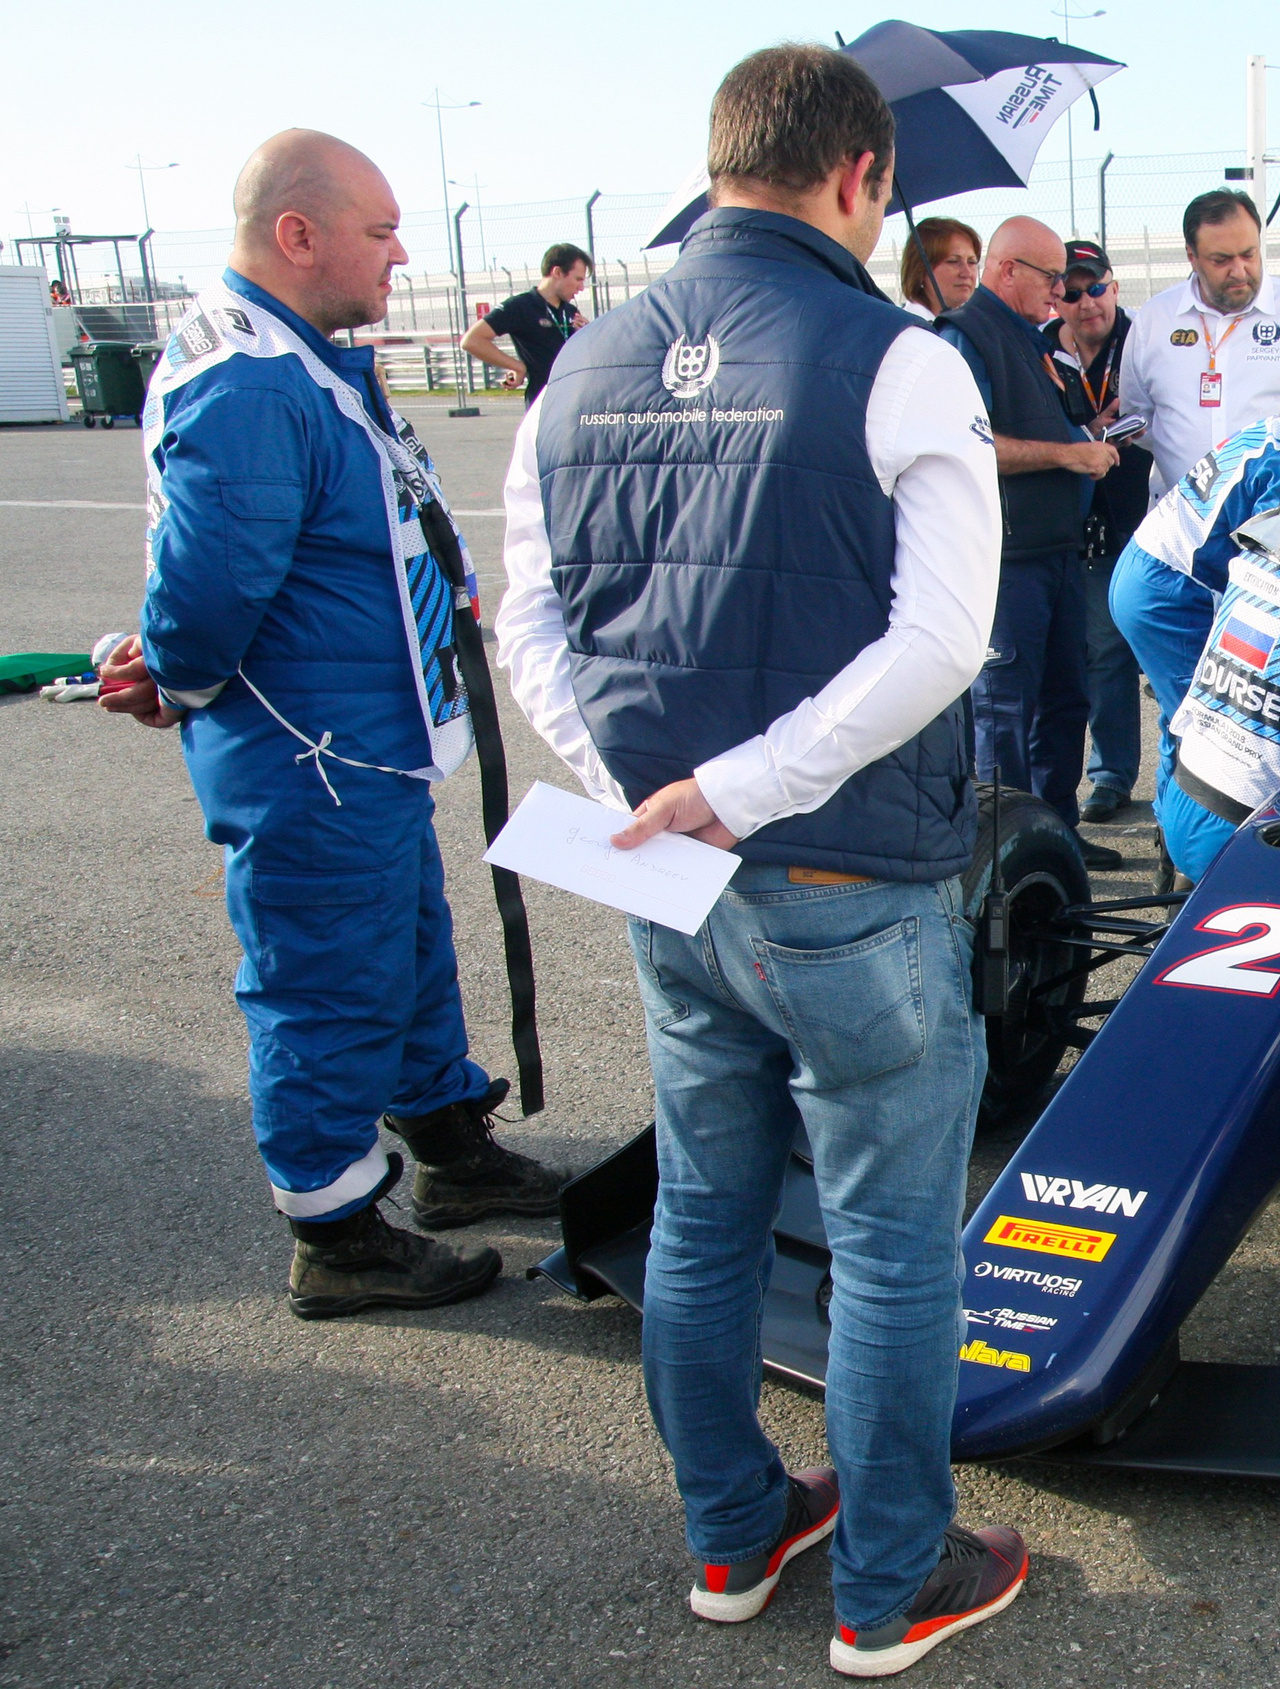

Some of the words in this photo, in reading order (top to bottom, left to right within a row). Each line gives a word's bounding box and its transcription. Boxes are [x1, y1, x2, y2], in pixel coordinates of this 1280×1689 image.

[1171, 331, 1196, 345] FIA
[579, 411, 625, 426] russian
[627, 407, 706, 425] automobile
[711, 406, 784, 422] federation
[1220, 730, 1244, 752] GRAND
[1244, 747, 1263, 761] PRIX
[997, 1221, 1103, 1254] PIRELLI
[993, 1264, 1083, 1292] VIRTUOSI
[1041, 1285, 1076, 1298] RACING
[993, 1317, 1025, 1331] TIME
[998, 1307, 1058, 1327] RUSSIAN
[959, 1339, 1031, 1373] llara
